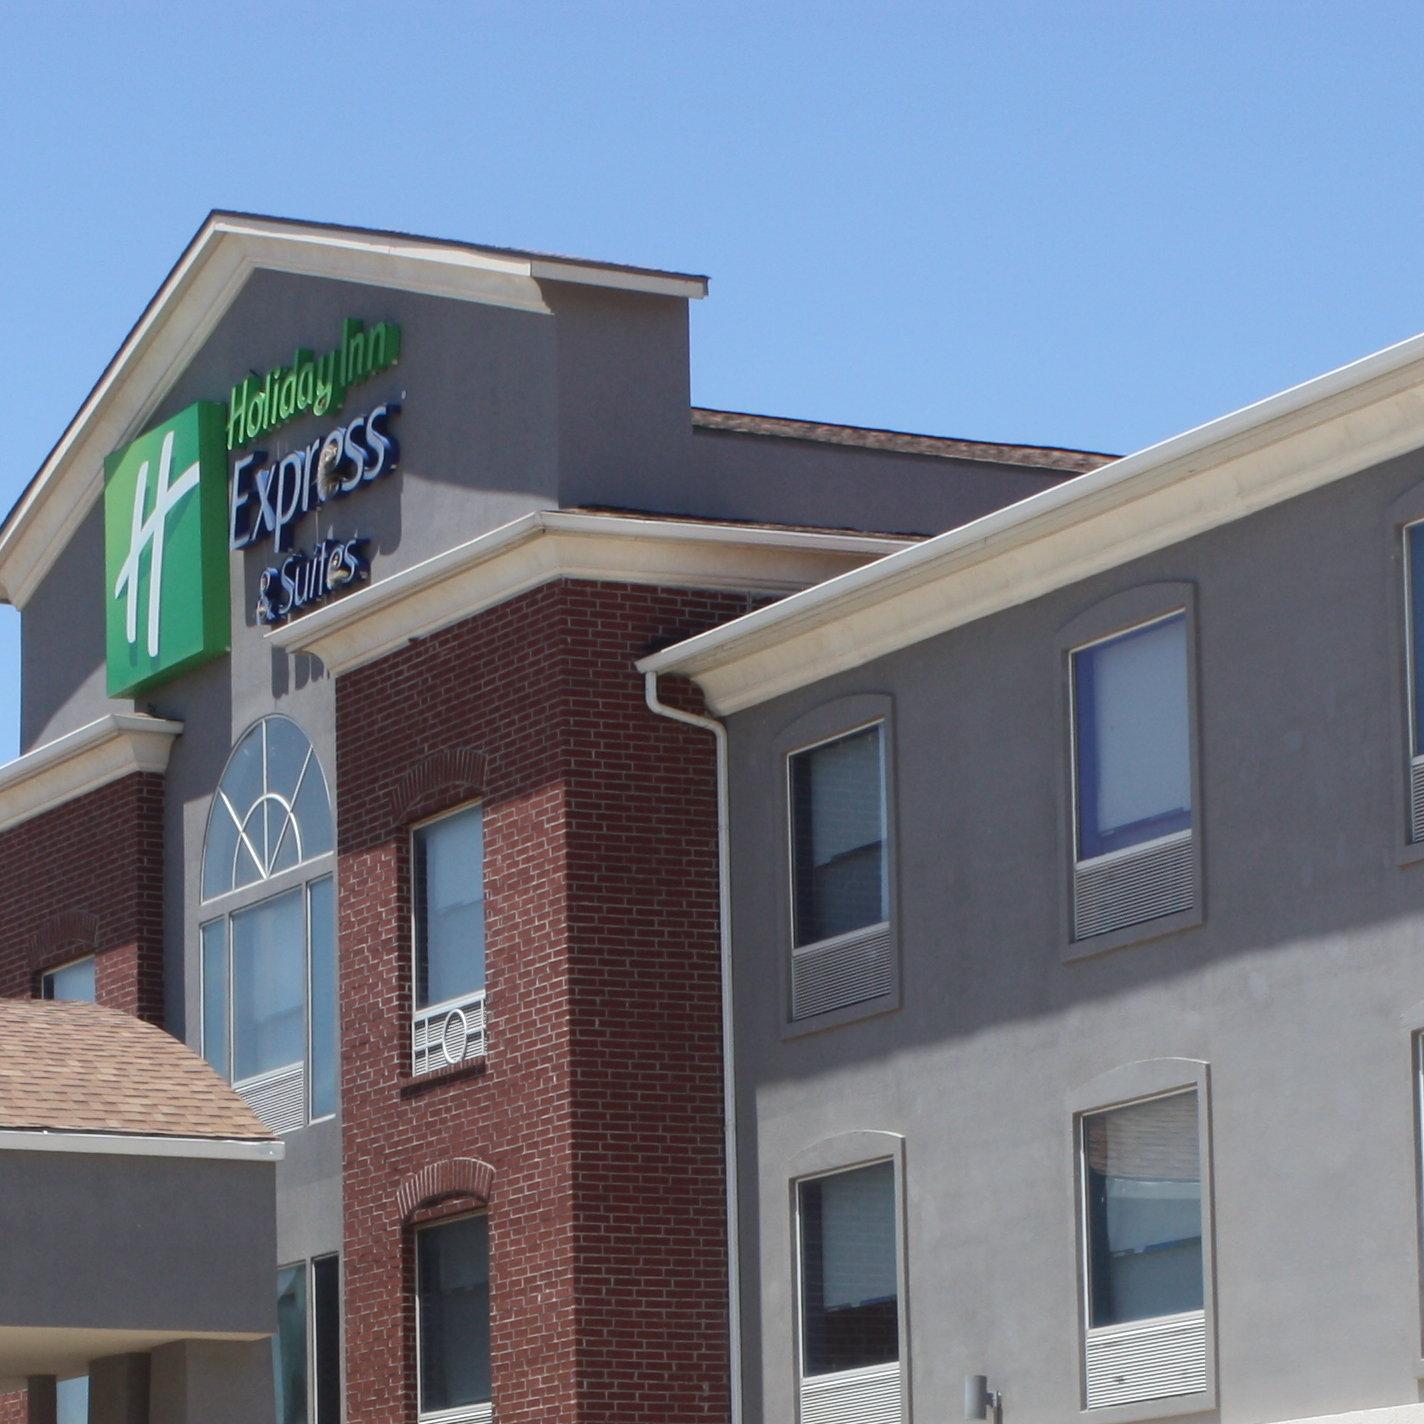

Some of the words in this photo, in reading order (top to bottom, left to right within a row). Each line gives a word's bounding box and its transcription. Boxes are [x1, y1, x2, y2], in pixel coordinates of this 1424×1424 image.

[227, 348, 342, 450] Holiday
[340, 318, 401, 387] Inn
[230, 404, 400, 553] Express
